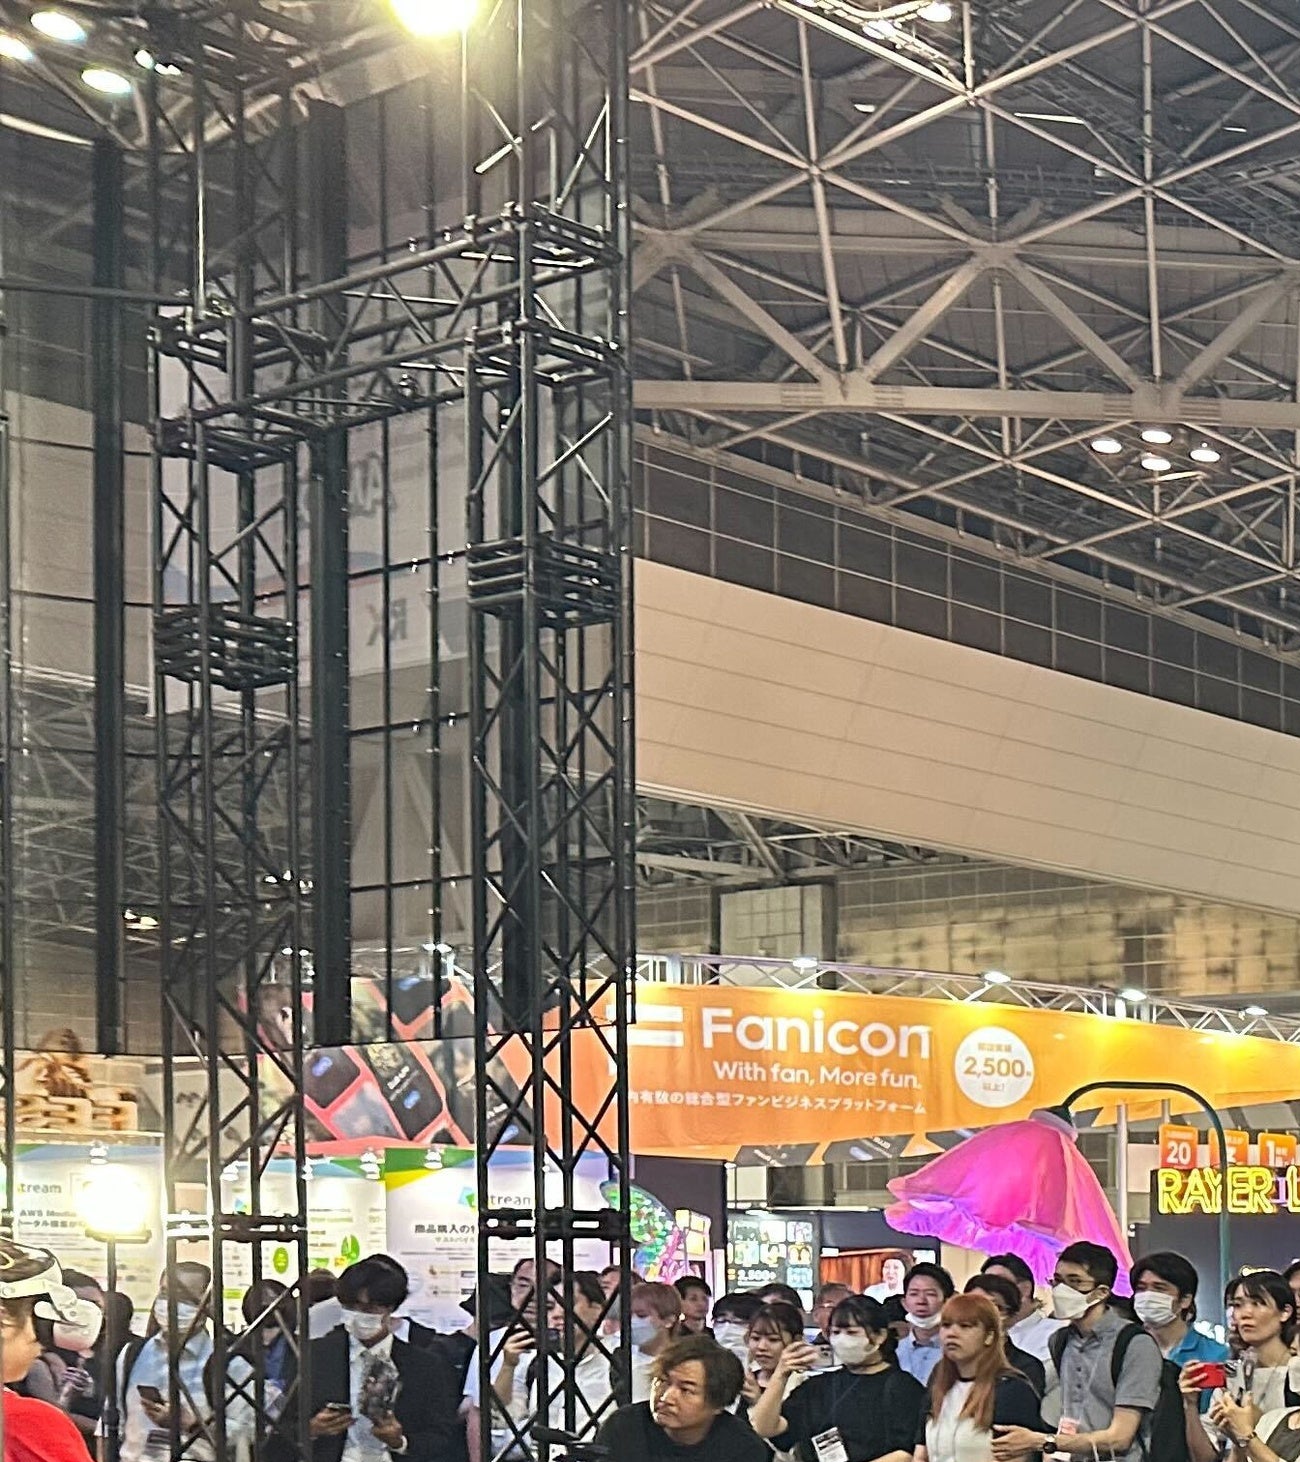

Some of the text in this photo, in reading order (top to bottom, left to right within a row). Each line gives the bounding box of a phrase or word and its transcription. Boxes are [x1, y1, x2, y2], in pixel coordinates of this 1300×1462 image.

[701, 1007, 931, 1060] Fanicon
[713, 1059, 922, 1090] With fan, More fun.
[1166, 1140, 1192, 1165] 20
[18, 1182, 62, 1194] tream
[1157, 1166, 1275, 1214] RAYER
